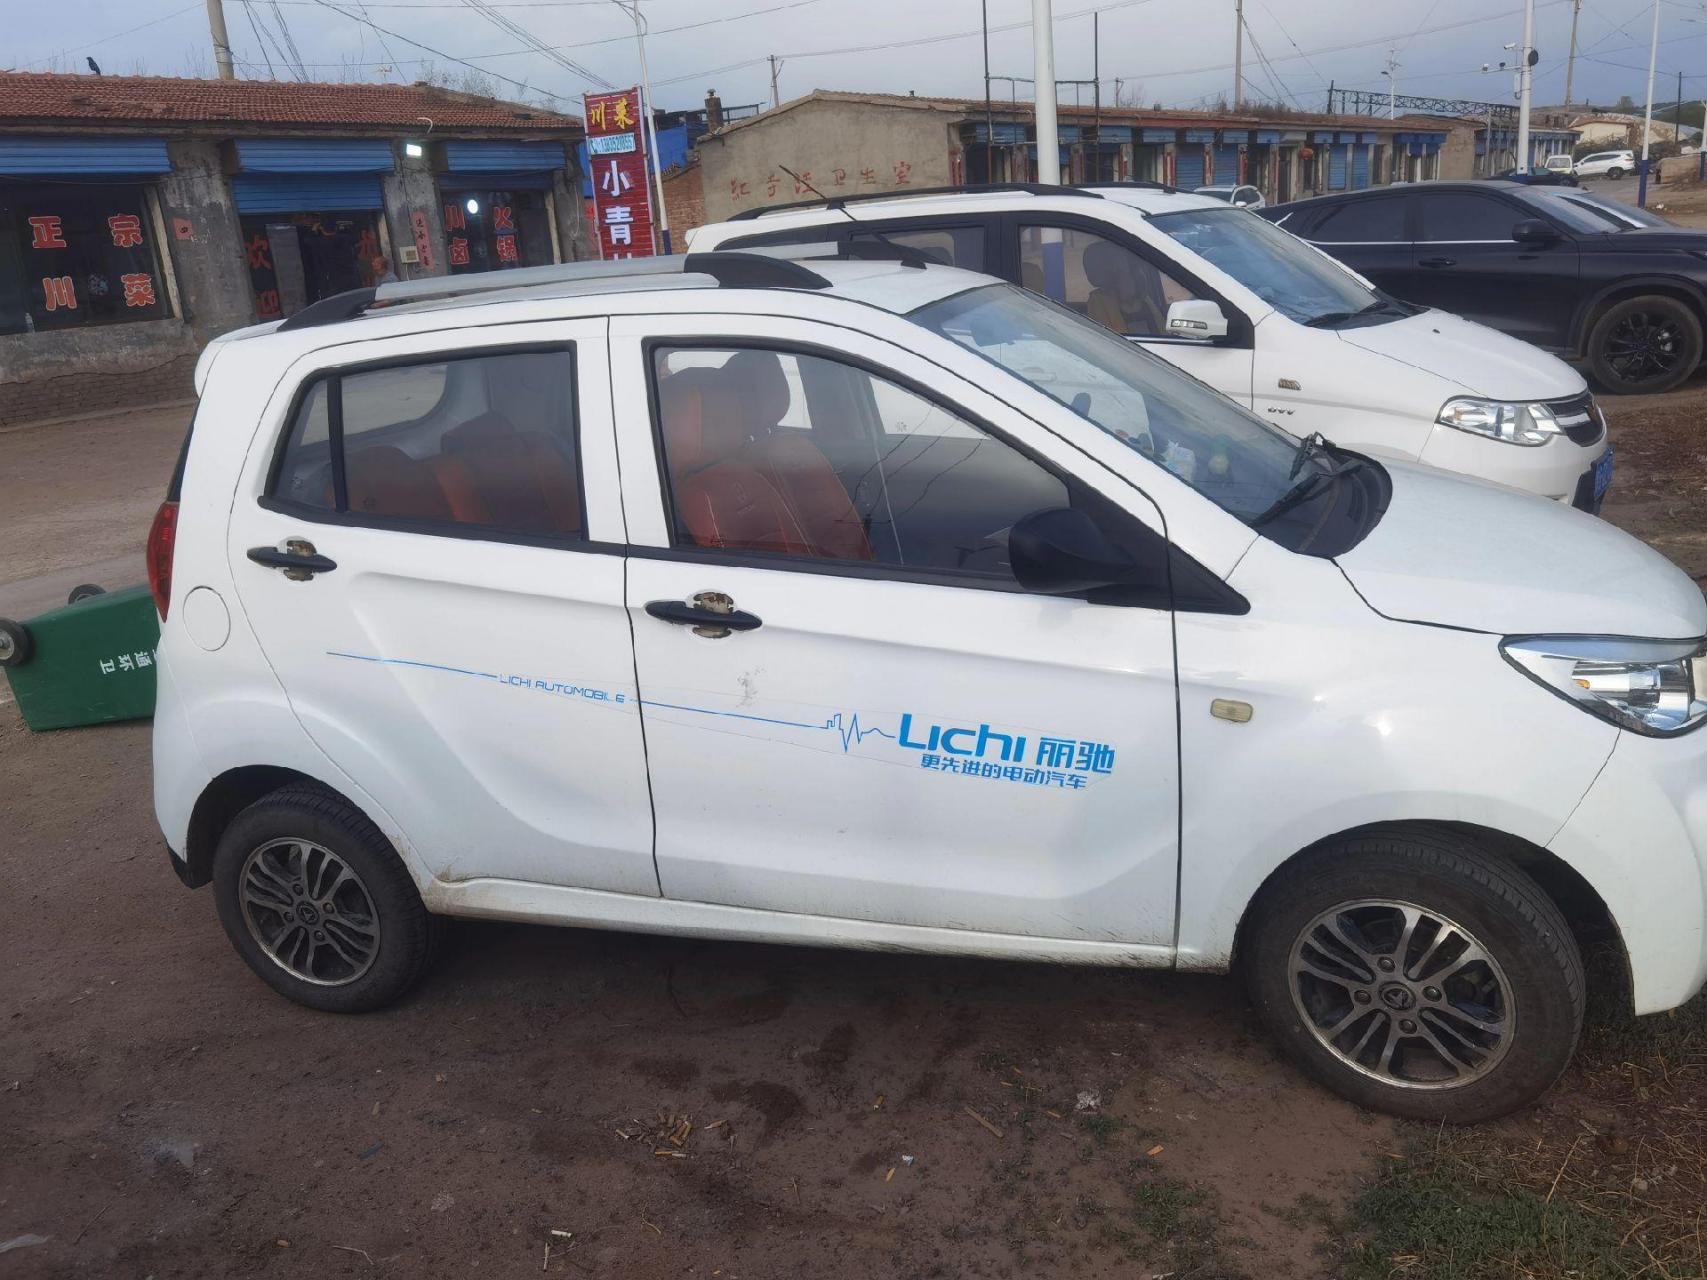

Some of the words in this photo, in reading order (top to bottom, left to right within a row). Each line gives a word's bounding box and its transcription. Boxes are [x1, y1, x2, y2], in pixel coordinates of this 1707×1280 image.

[602, 160, 634, 260] 小青
[28, 213, 144, 249] 正宗
[500, 673, 531, 689] LICHI
[535, 680, 625, 703] AUTOMOBILE
[920, 753, 1088, 790] 更先进的电动汽车
[1036, 736, 1116, 774] 丽驰
